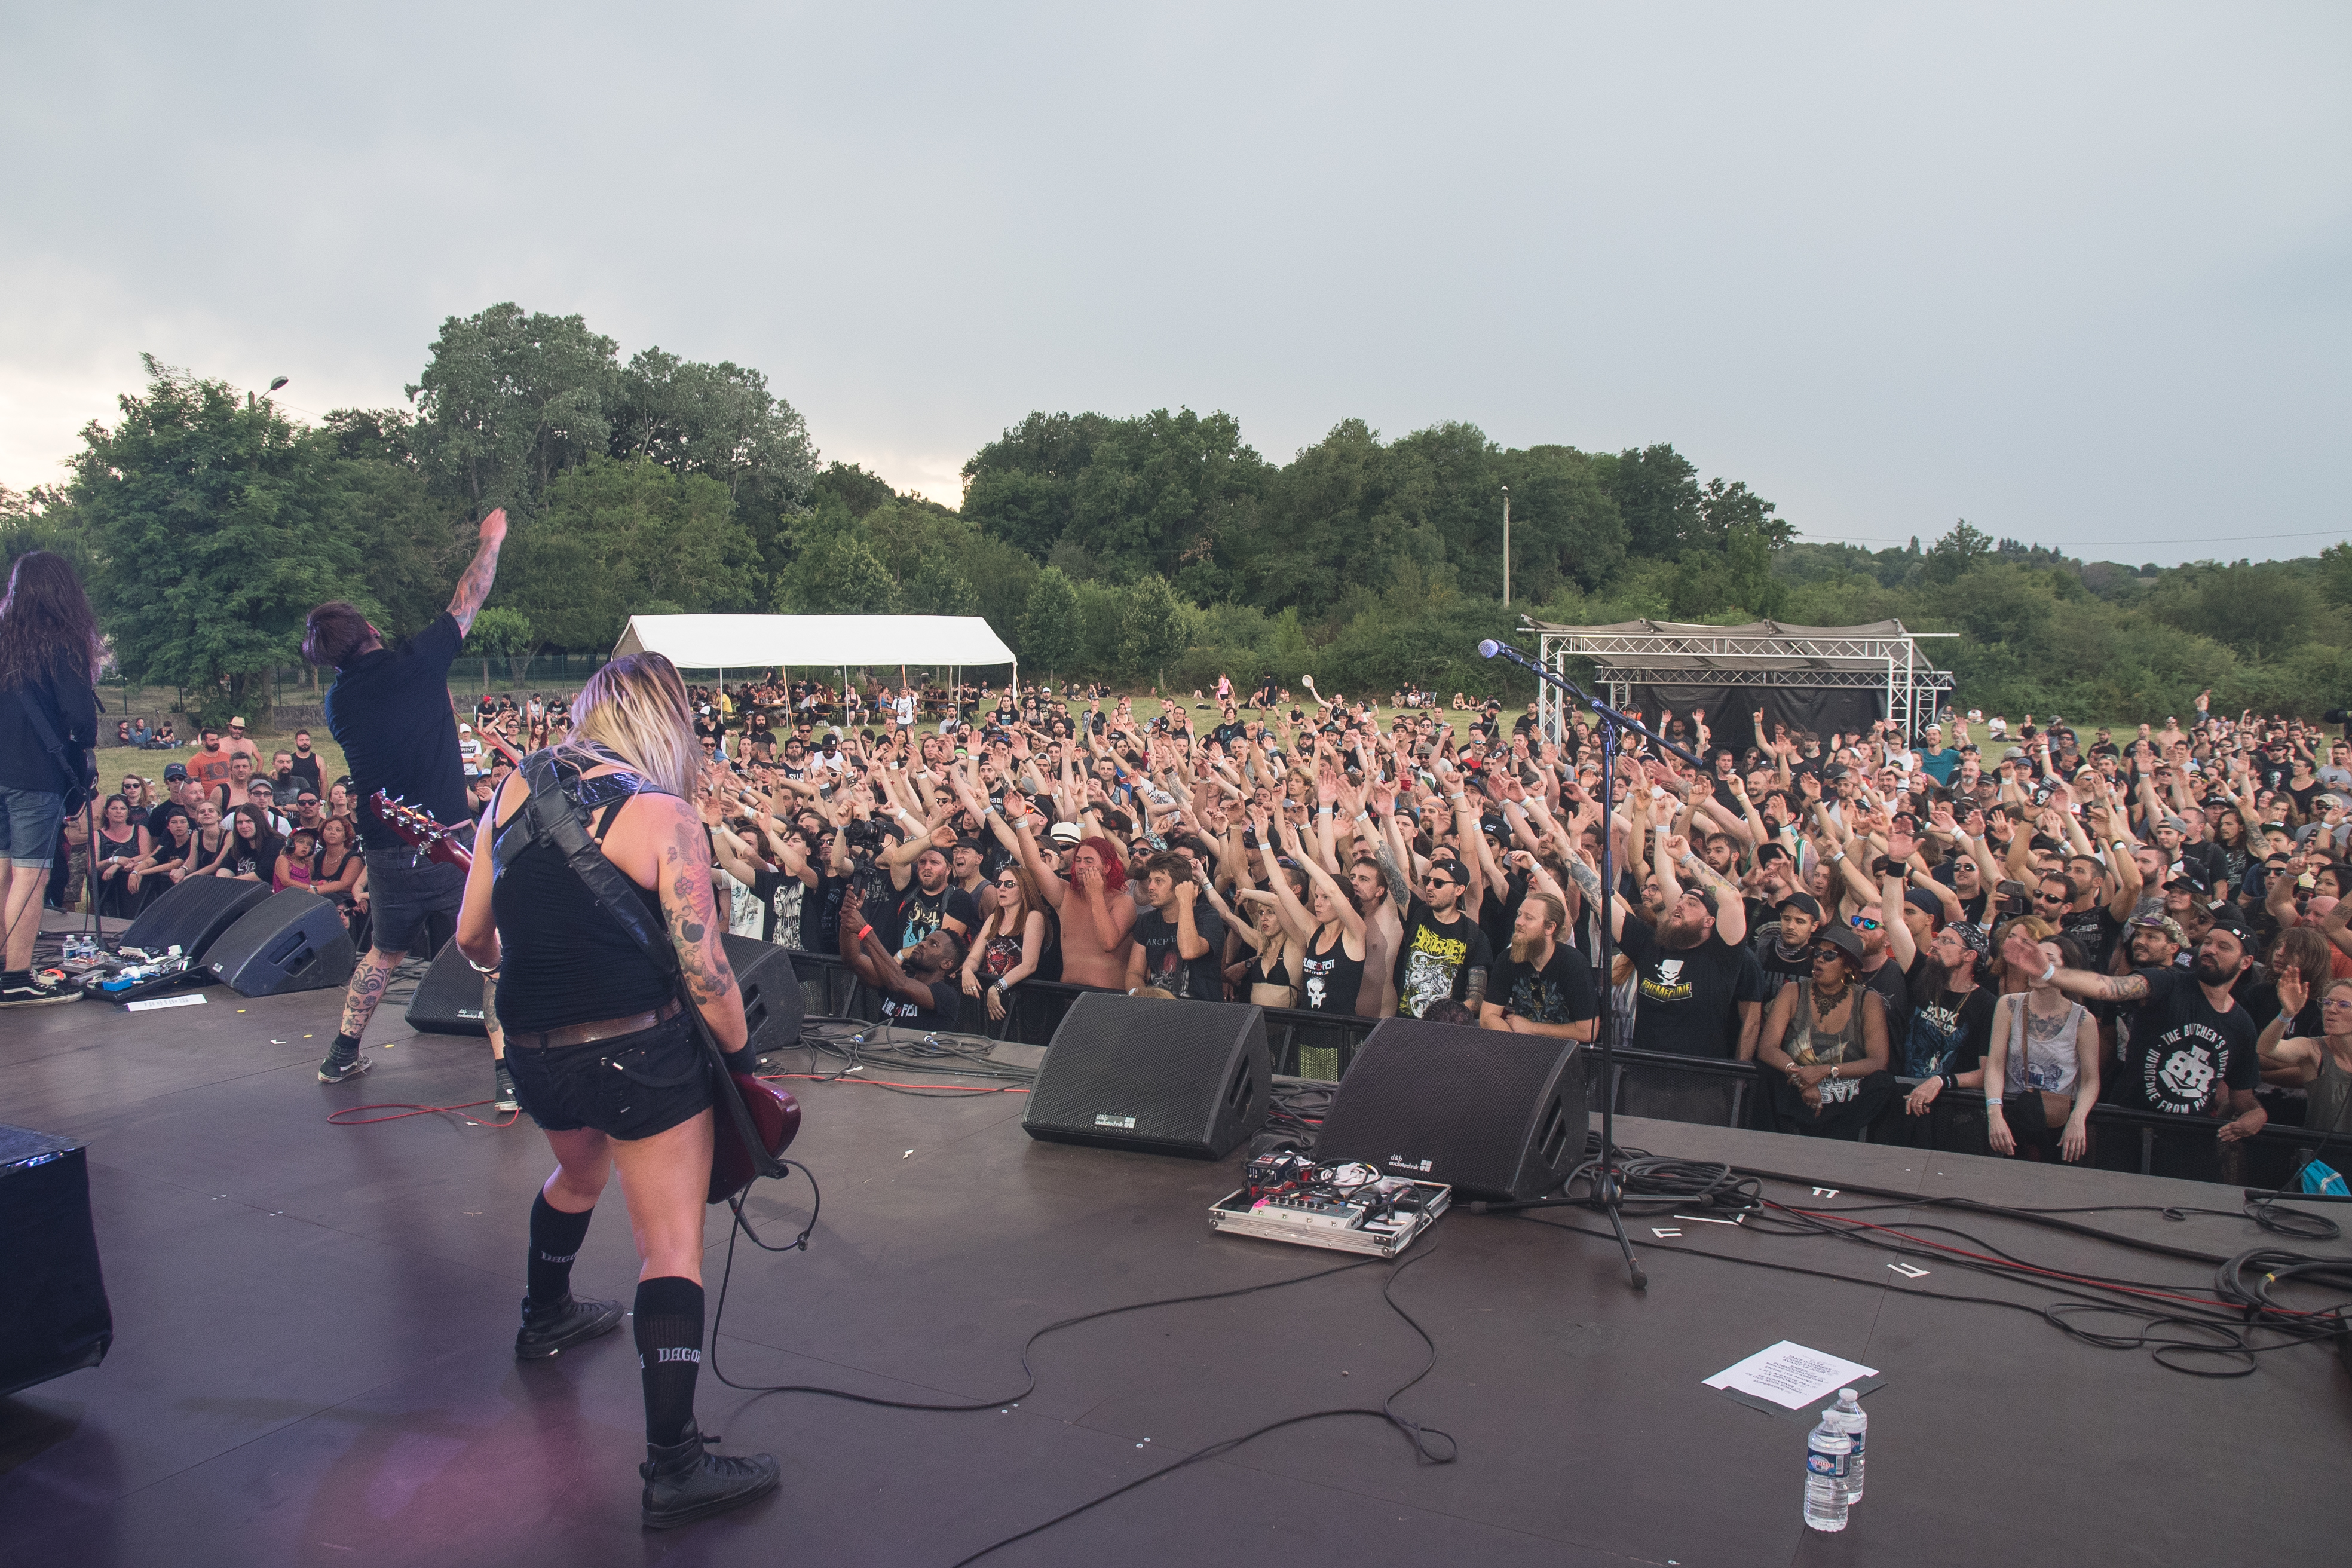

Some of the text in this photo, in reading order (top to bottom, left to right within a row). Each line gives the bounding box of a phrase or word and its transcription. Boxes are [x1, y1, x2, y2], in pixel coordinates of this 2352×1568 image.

[2160, 1028, 2182, 1045] THE
[2183, 1023, 2227, 1049] BUTCHER'S
[2157, 1100, 2189, 1114] FROM
